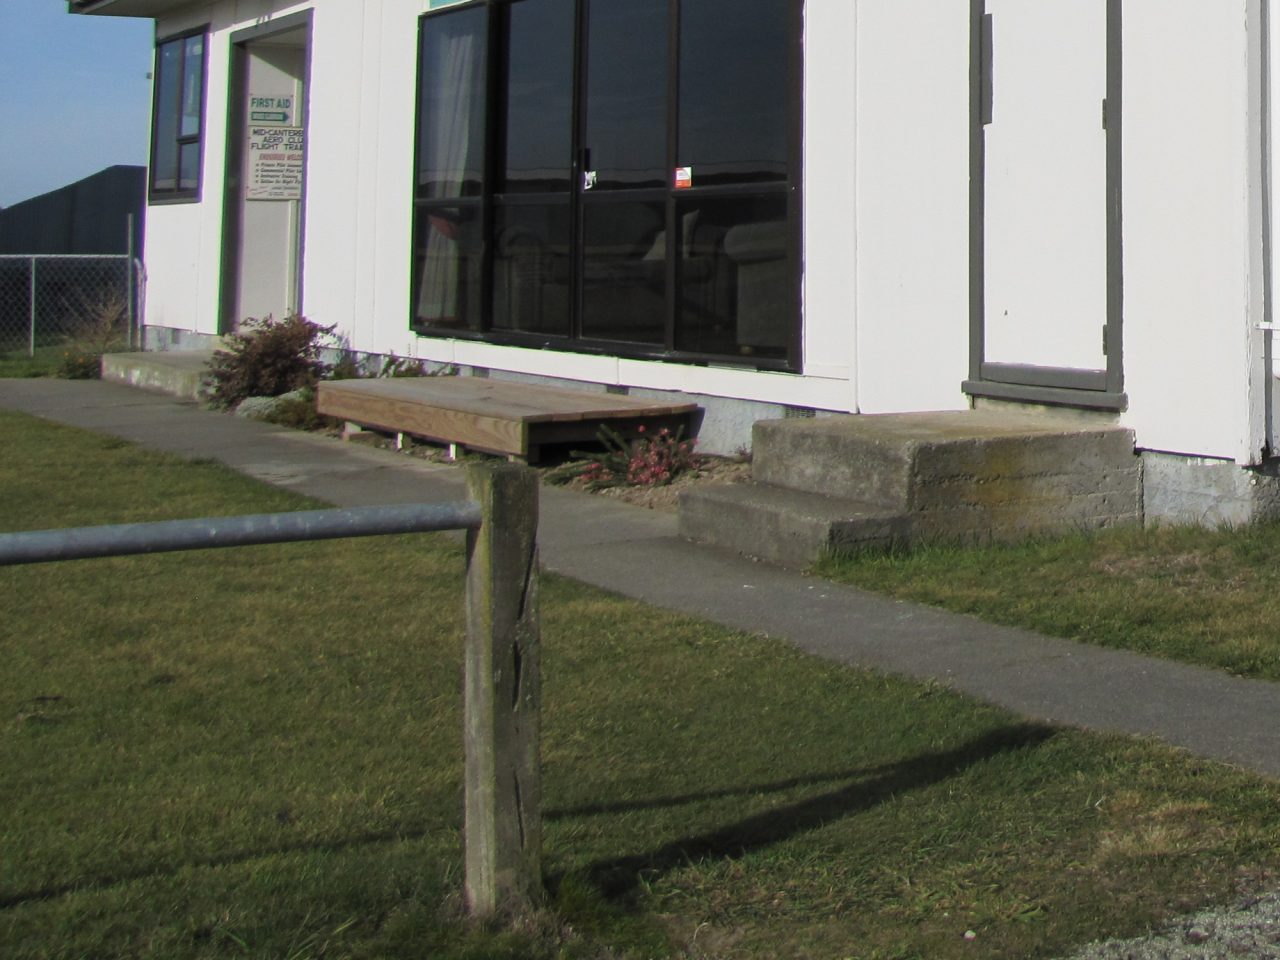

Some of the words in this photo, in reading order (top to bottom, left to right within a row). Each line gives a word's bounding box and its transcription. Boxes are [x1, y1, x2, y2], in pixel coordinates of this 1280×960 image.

[251, 97, 274, 108] FIRST
[276, 98, 291, 109] AID
[263, 136, 284, 144] AERO
[250, 142, 279, 151] FLIGHT
